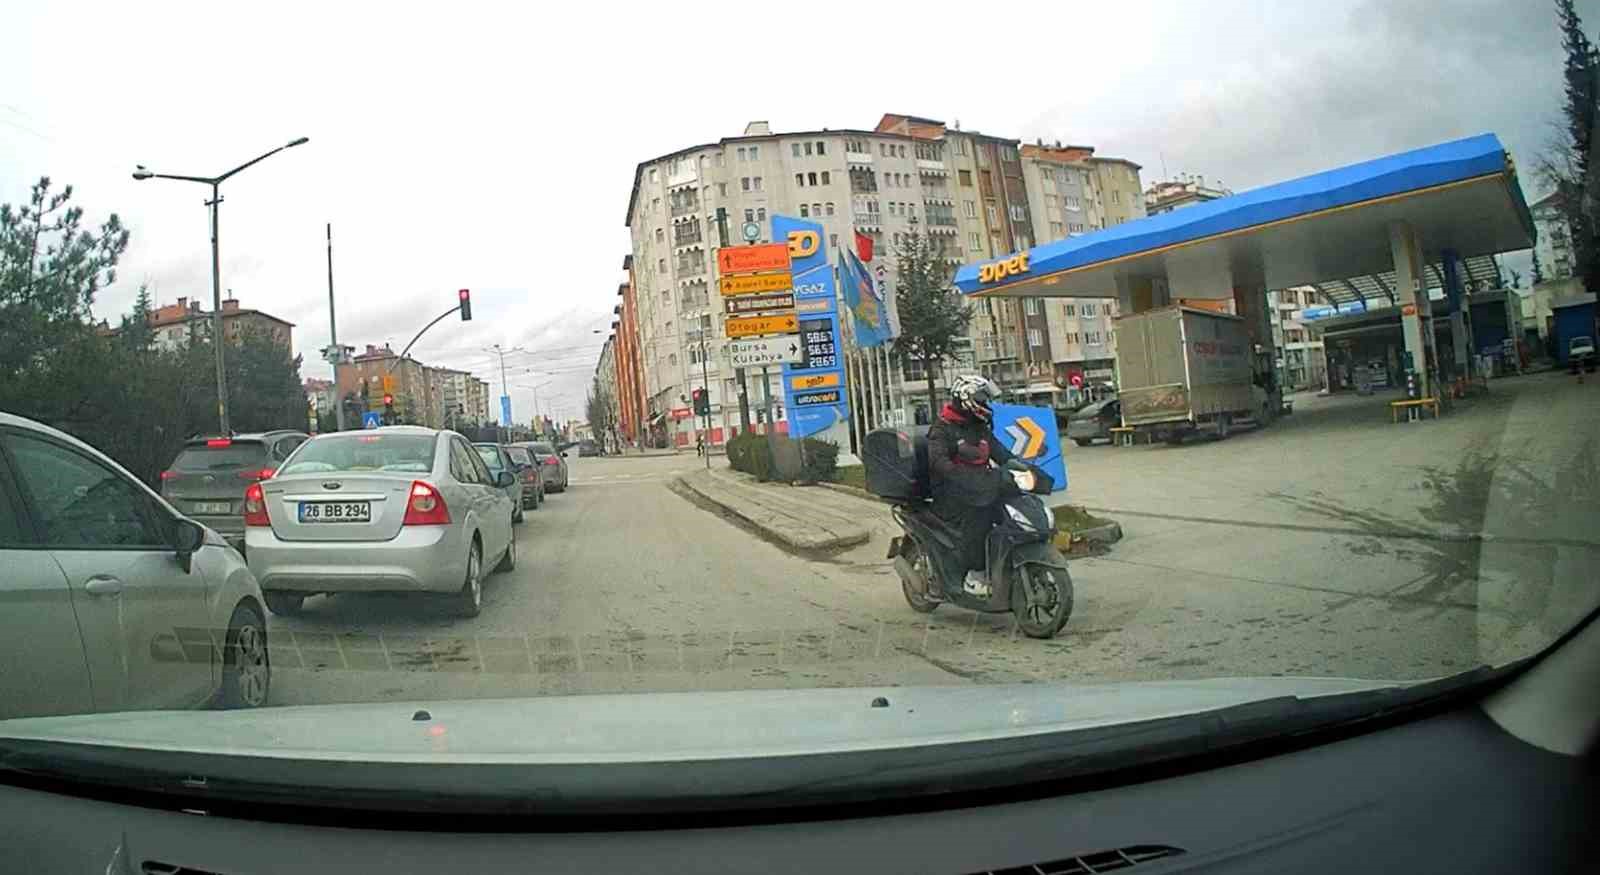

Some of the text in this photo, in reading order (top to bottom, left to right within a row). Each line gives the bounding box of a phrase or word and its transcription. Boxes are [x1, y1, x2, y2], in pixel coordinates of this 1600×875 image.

[729, 322, 770, 333] Otogar
[731, 343, 768, 353] Bursa
[305, 504, 368, 517] 26 BB 294
